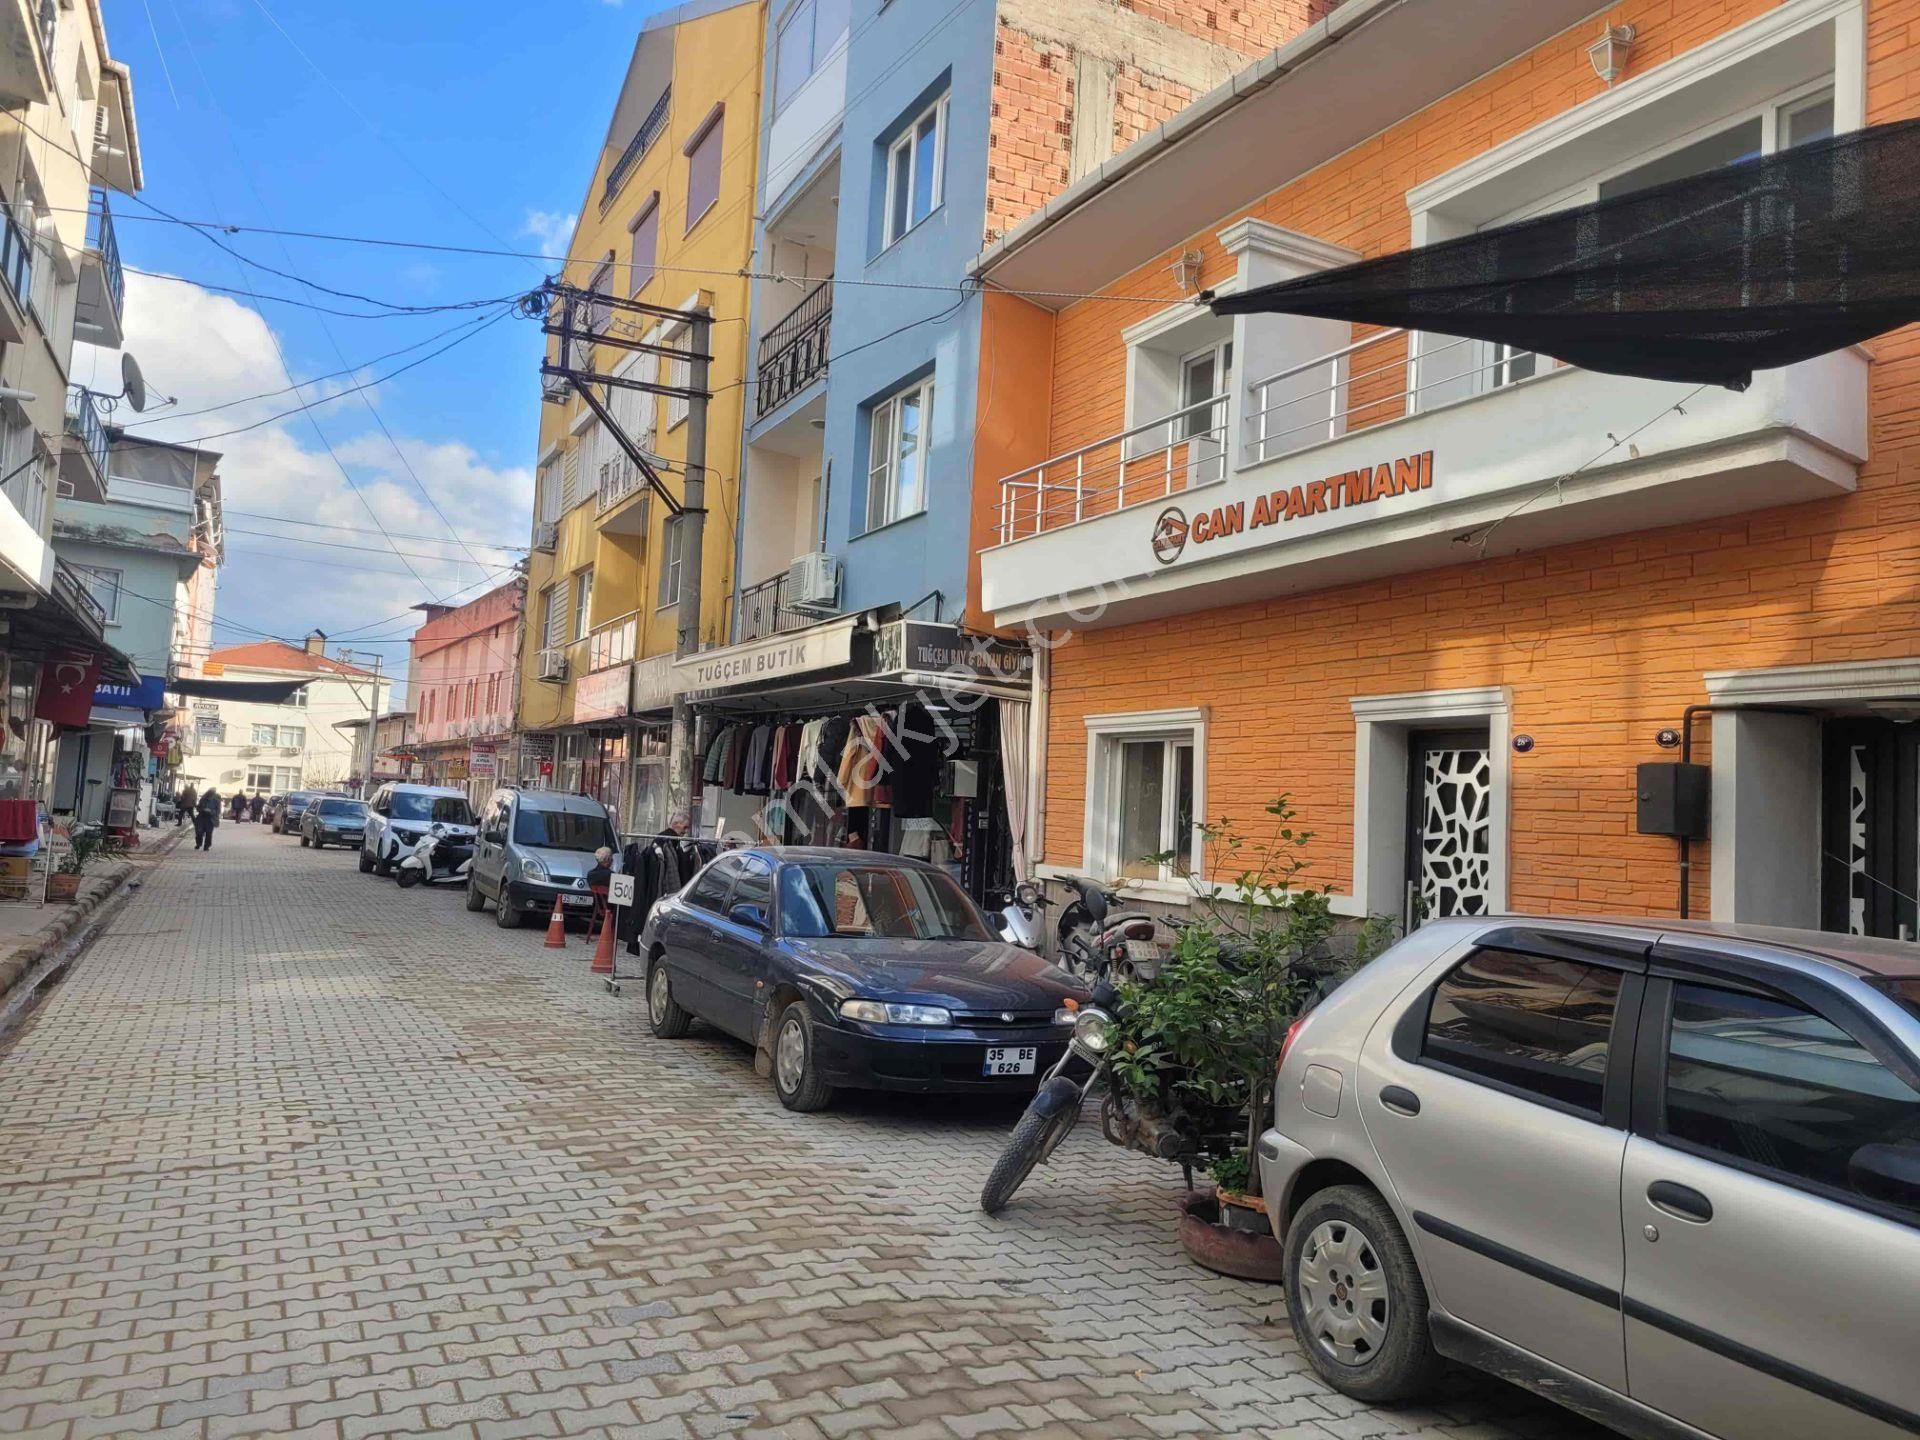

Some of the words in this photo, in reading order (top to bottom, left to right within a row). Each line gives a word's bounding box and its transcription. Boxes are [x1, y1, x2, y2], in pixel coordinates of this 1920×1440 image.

[1191, 501, 1245, 545] CAN
[1250, 450, 1434, 529] APARTMANI
[697, 656, 752, 683] TUĞÇEM
[756, 643, 806, 674] BUTİK
[917, 644, 949, 668] TUĞÇEM
[951, 648, 967, 664] BAY
[614, 882, 633, 901] 500
[989, 1049, 1005, 1061] 35
[1018, 1048, 1034, 1060] BE
[997, 1062, 1021, 1074] 626
